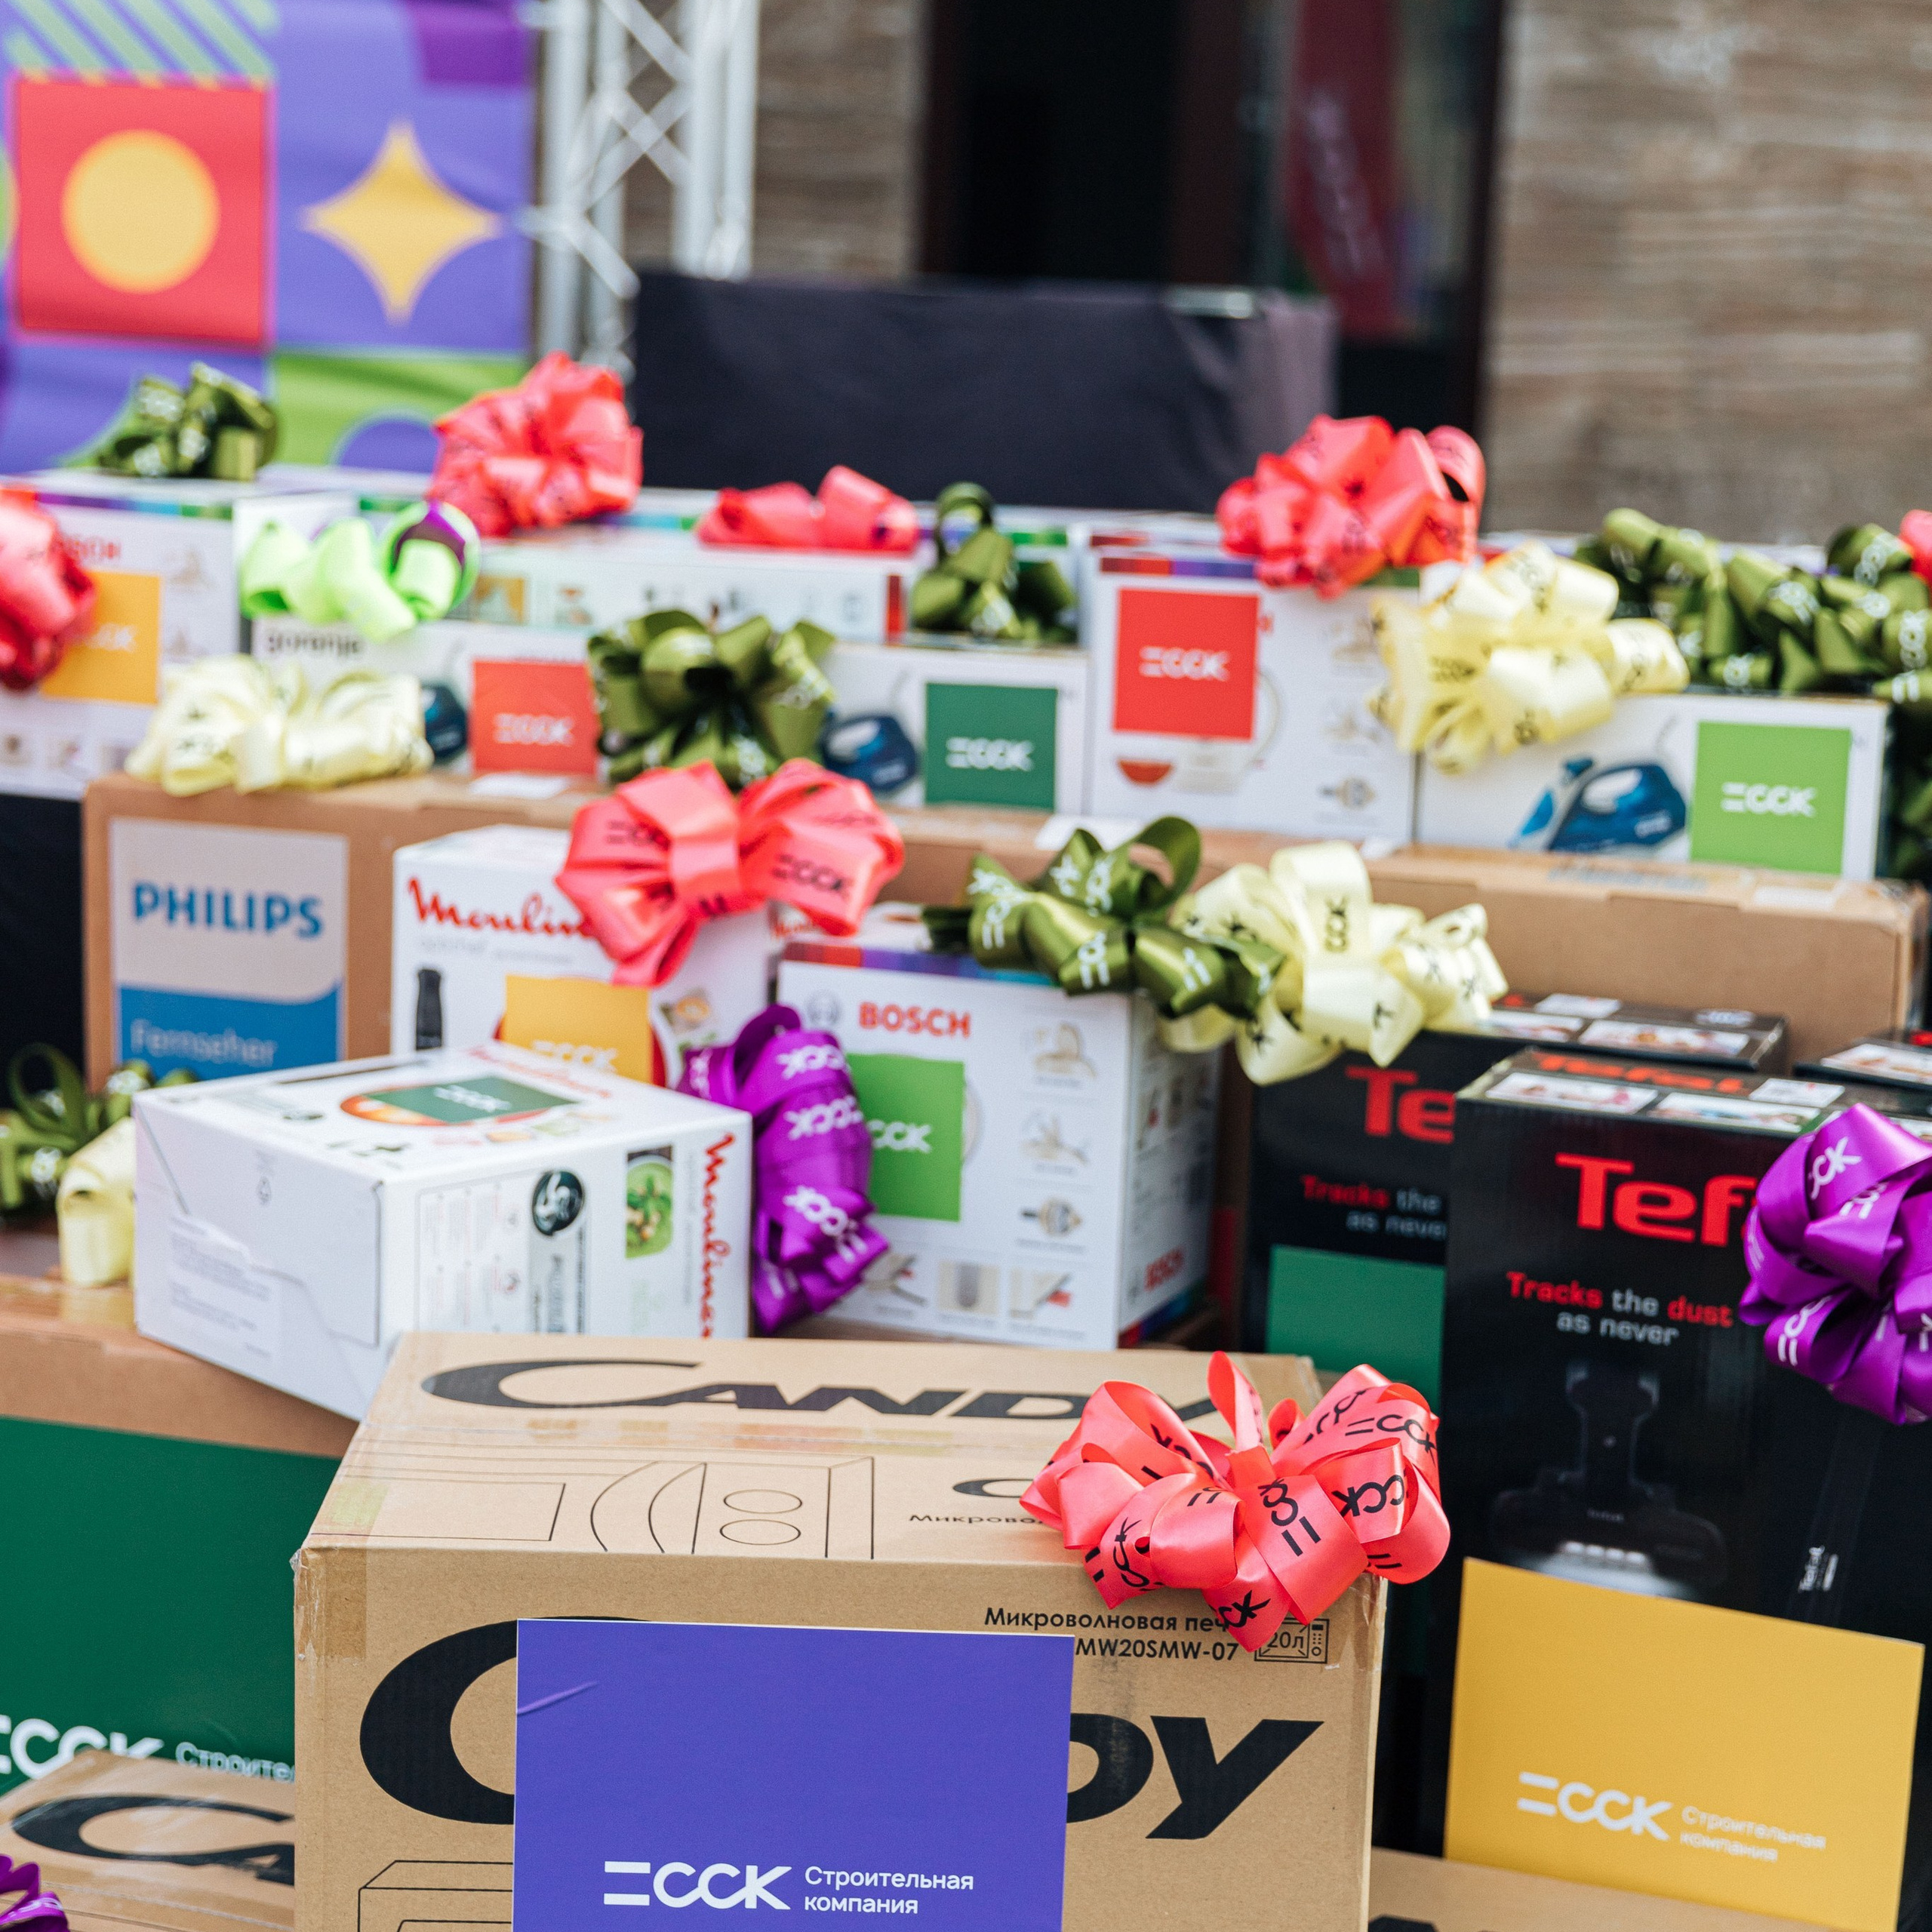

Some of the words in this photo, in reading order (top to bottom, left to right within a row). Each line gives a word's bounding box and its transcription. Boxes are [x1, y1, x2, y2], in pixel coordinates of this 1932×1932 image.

[134, 880, 323, 939] PHILIPS
[408, 877, 580, 936] Moulin
[859, 1001, 971, 1038] BOSCH
[1397, 1187, 1442, 1216] the
[1555, 1152, 1758, 1247] Tef
[1346, 1210, 1380, 1234] as
[1385, 1214, 1447, 1241] neve
[1506, 1271, 1604, 1310] Tracks
[1611, 1287, 1660, 1318] the
[1667, 1294, 1734, 1328] dust
[1556, 1311, 1591, 1335] as
[1599, 1318, 1680, 1347] never
[909, 1513, 1043, 1524] Микрово
[984, 1607, 1178, 1631] Микроволновая
[1185, 1616, 1228, 1632] печ
[1681, 1805, 1827, 1850] Строительная
[1680, 1831, 1779, 1863] компания
[804, 1865, 974, 1891] Строительная
[804, 1895, 919, 1915] компания
